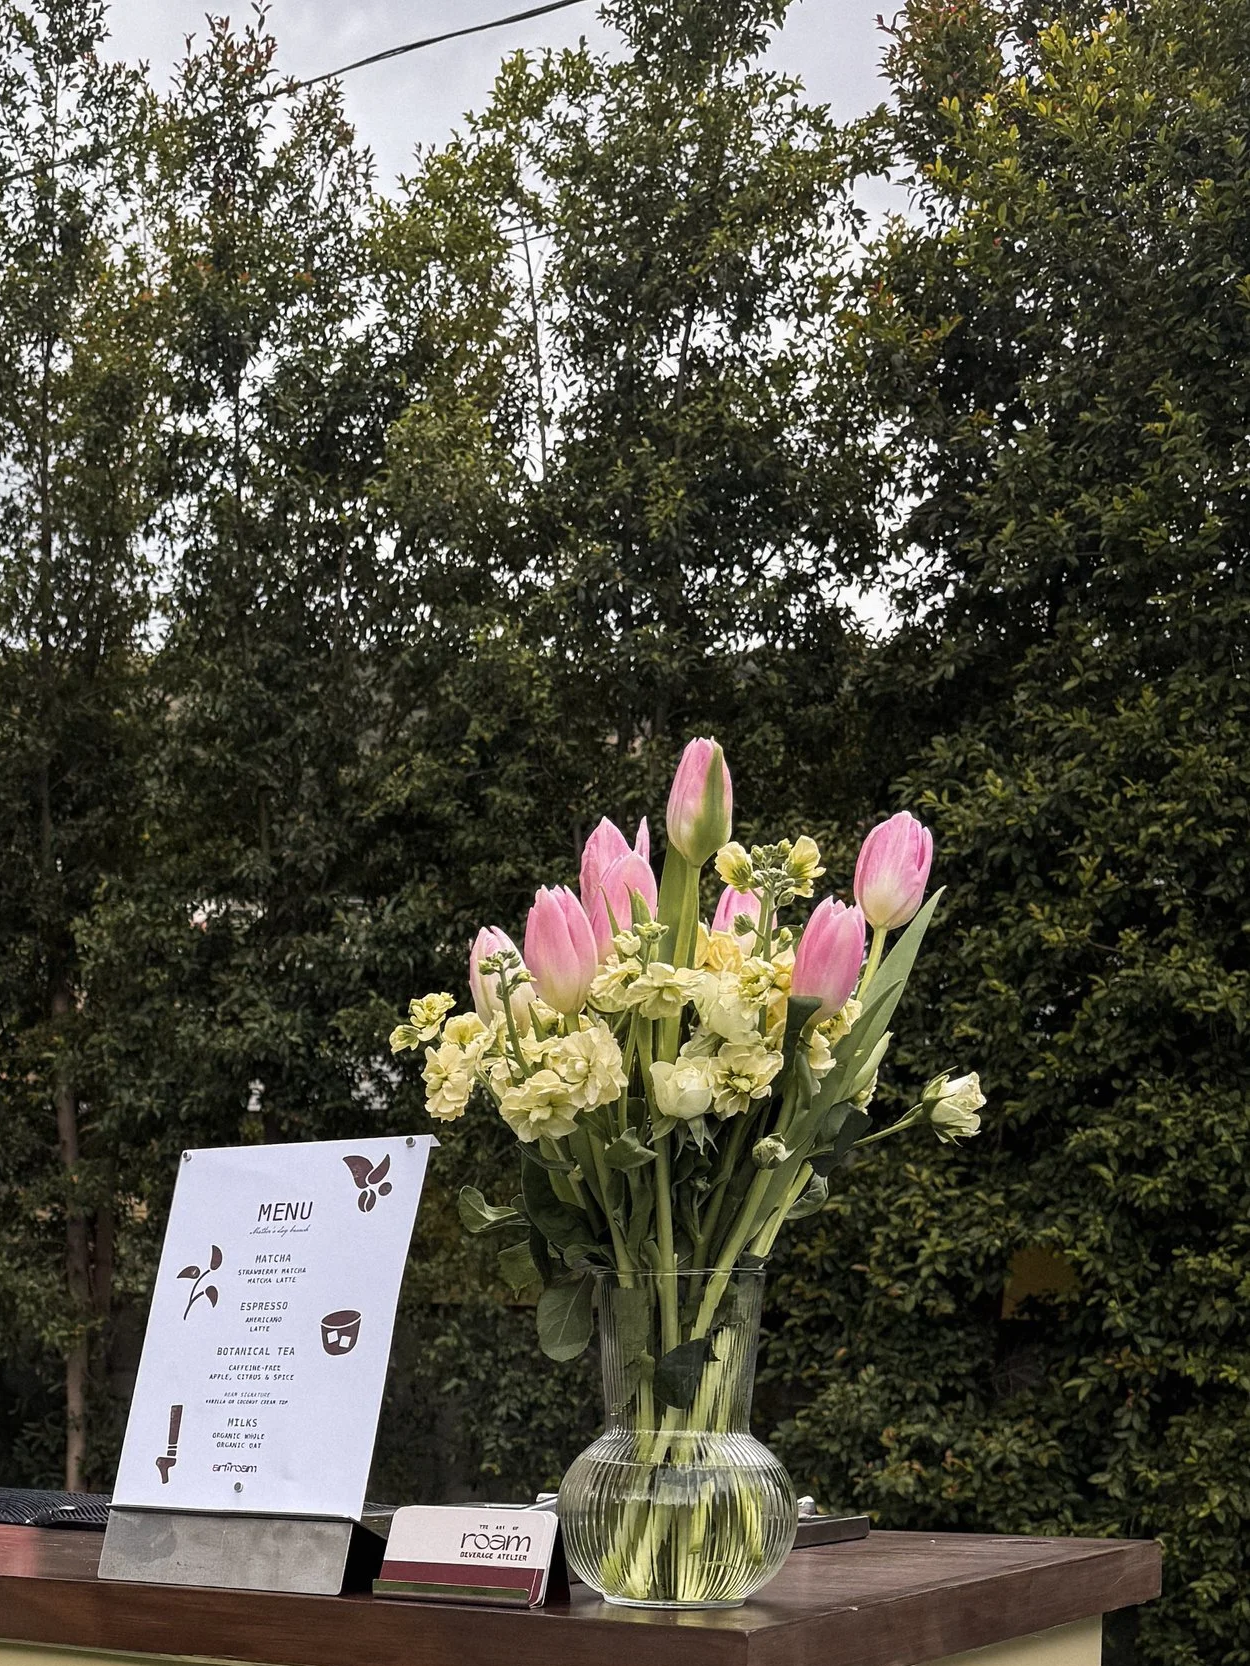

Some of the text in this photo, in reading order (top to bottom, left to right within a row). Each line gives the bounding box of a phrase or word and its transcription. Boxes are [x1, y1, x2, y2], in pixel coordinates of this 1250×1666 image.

[257, 1201, 313, 1222] MENU
[255, 1253, 292, 1264] MATCHA
[238, 1268, 278, 1276] STRAWBERRY
[275, 1276, 297, 1284] LATTE
[240, 1301, 289, 1311] ESPRESSO
[249, 1325, 271, 1333] LATTE
[216, 1346, 296, 1356] BOTANICAL TEA
[228, 1364, 282, 1372] CAFFEINE-FREE
[208, 1373, 233, 1381] APPLE,
[227, 1418, 258, 1428] MILKS
[212, 1432, 241, 1440] ORGANIC
[216, 1441, 246, 1449] ORGANIC
[460, 1533, 531, 1552] roam
